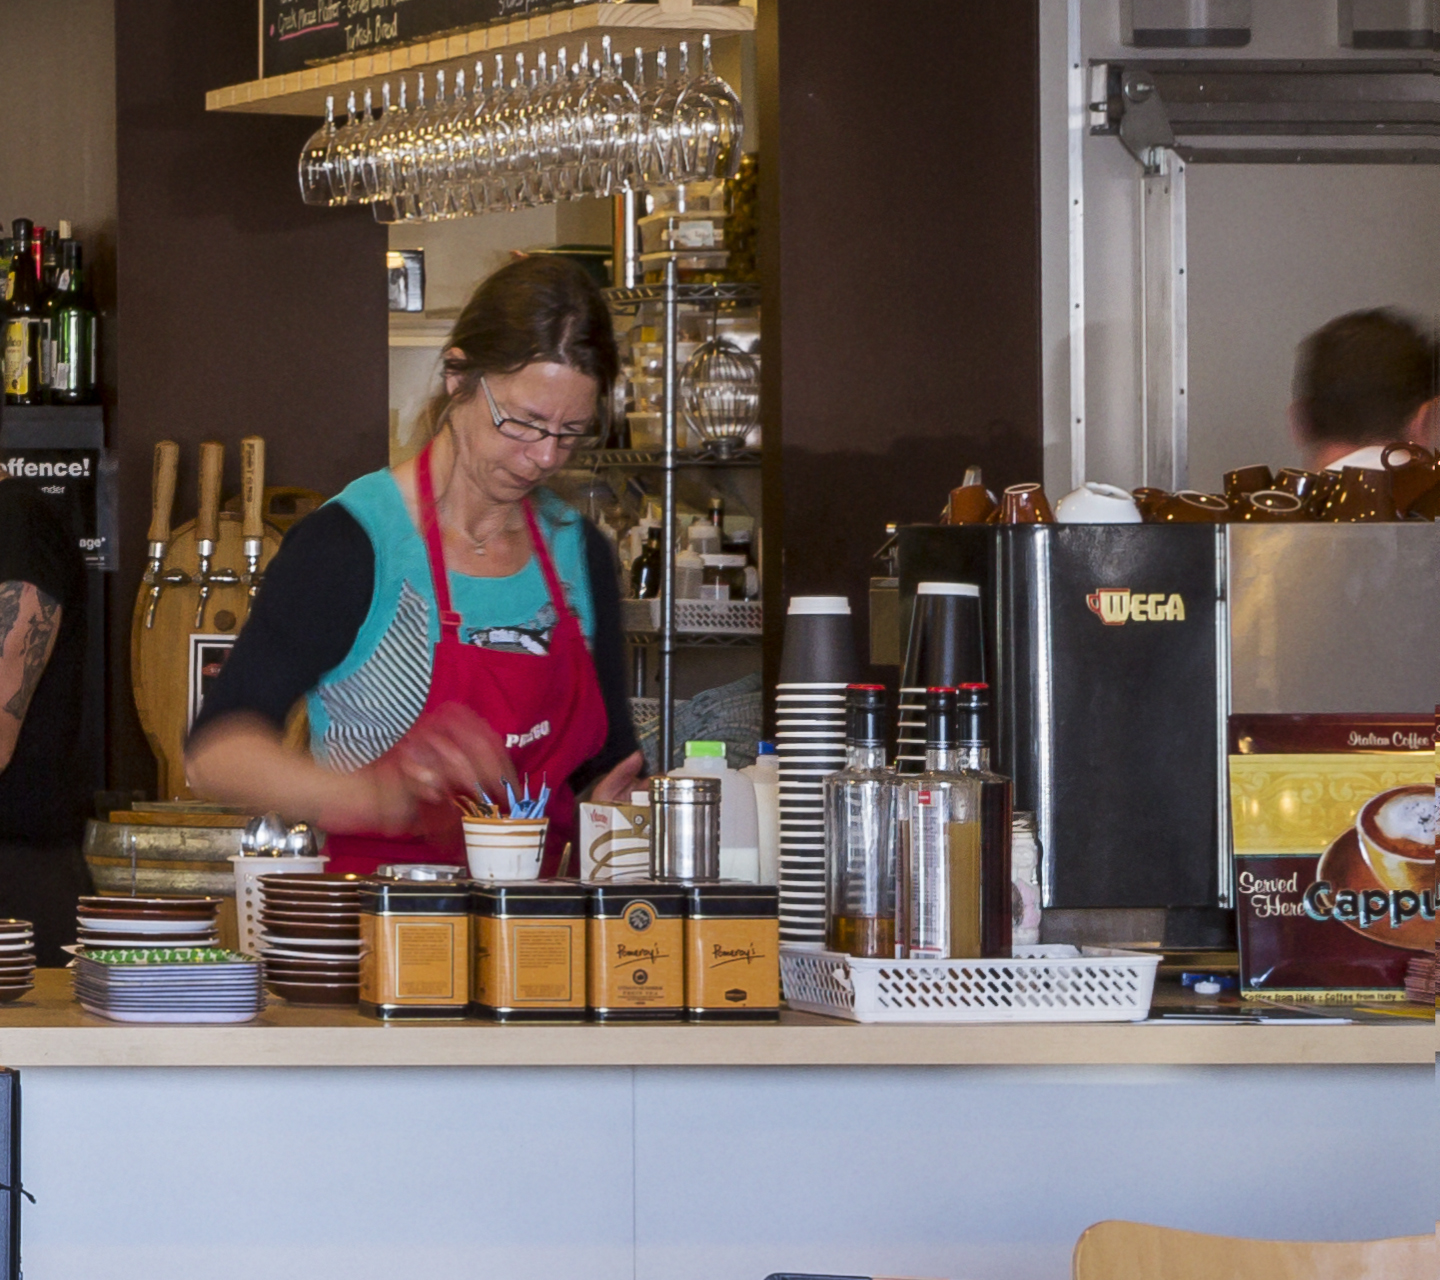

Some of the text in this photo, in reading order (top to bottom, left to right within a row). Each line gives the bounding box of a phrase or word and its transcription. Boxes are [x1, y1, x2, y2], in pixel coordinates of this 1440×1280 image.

[1099, 590, 1186, 622] WEGA
[1347, 731, 1430, 750] Italian Coffee
[1238, 871, 1299, 894] Served
[1250, 894, 1306, 918] Here
[616, 942, 662, 964] Pomeroy's
[713, 942, 758, 965] Pomeroy's
[1324, 992, 1353, 1002] Coffee
[1356, 992, 1375, 1002] from
